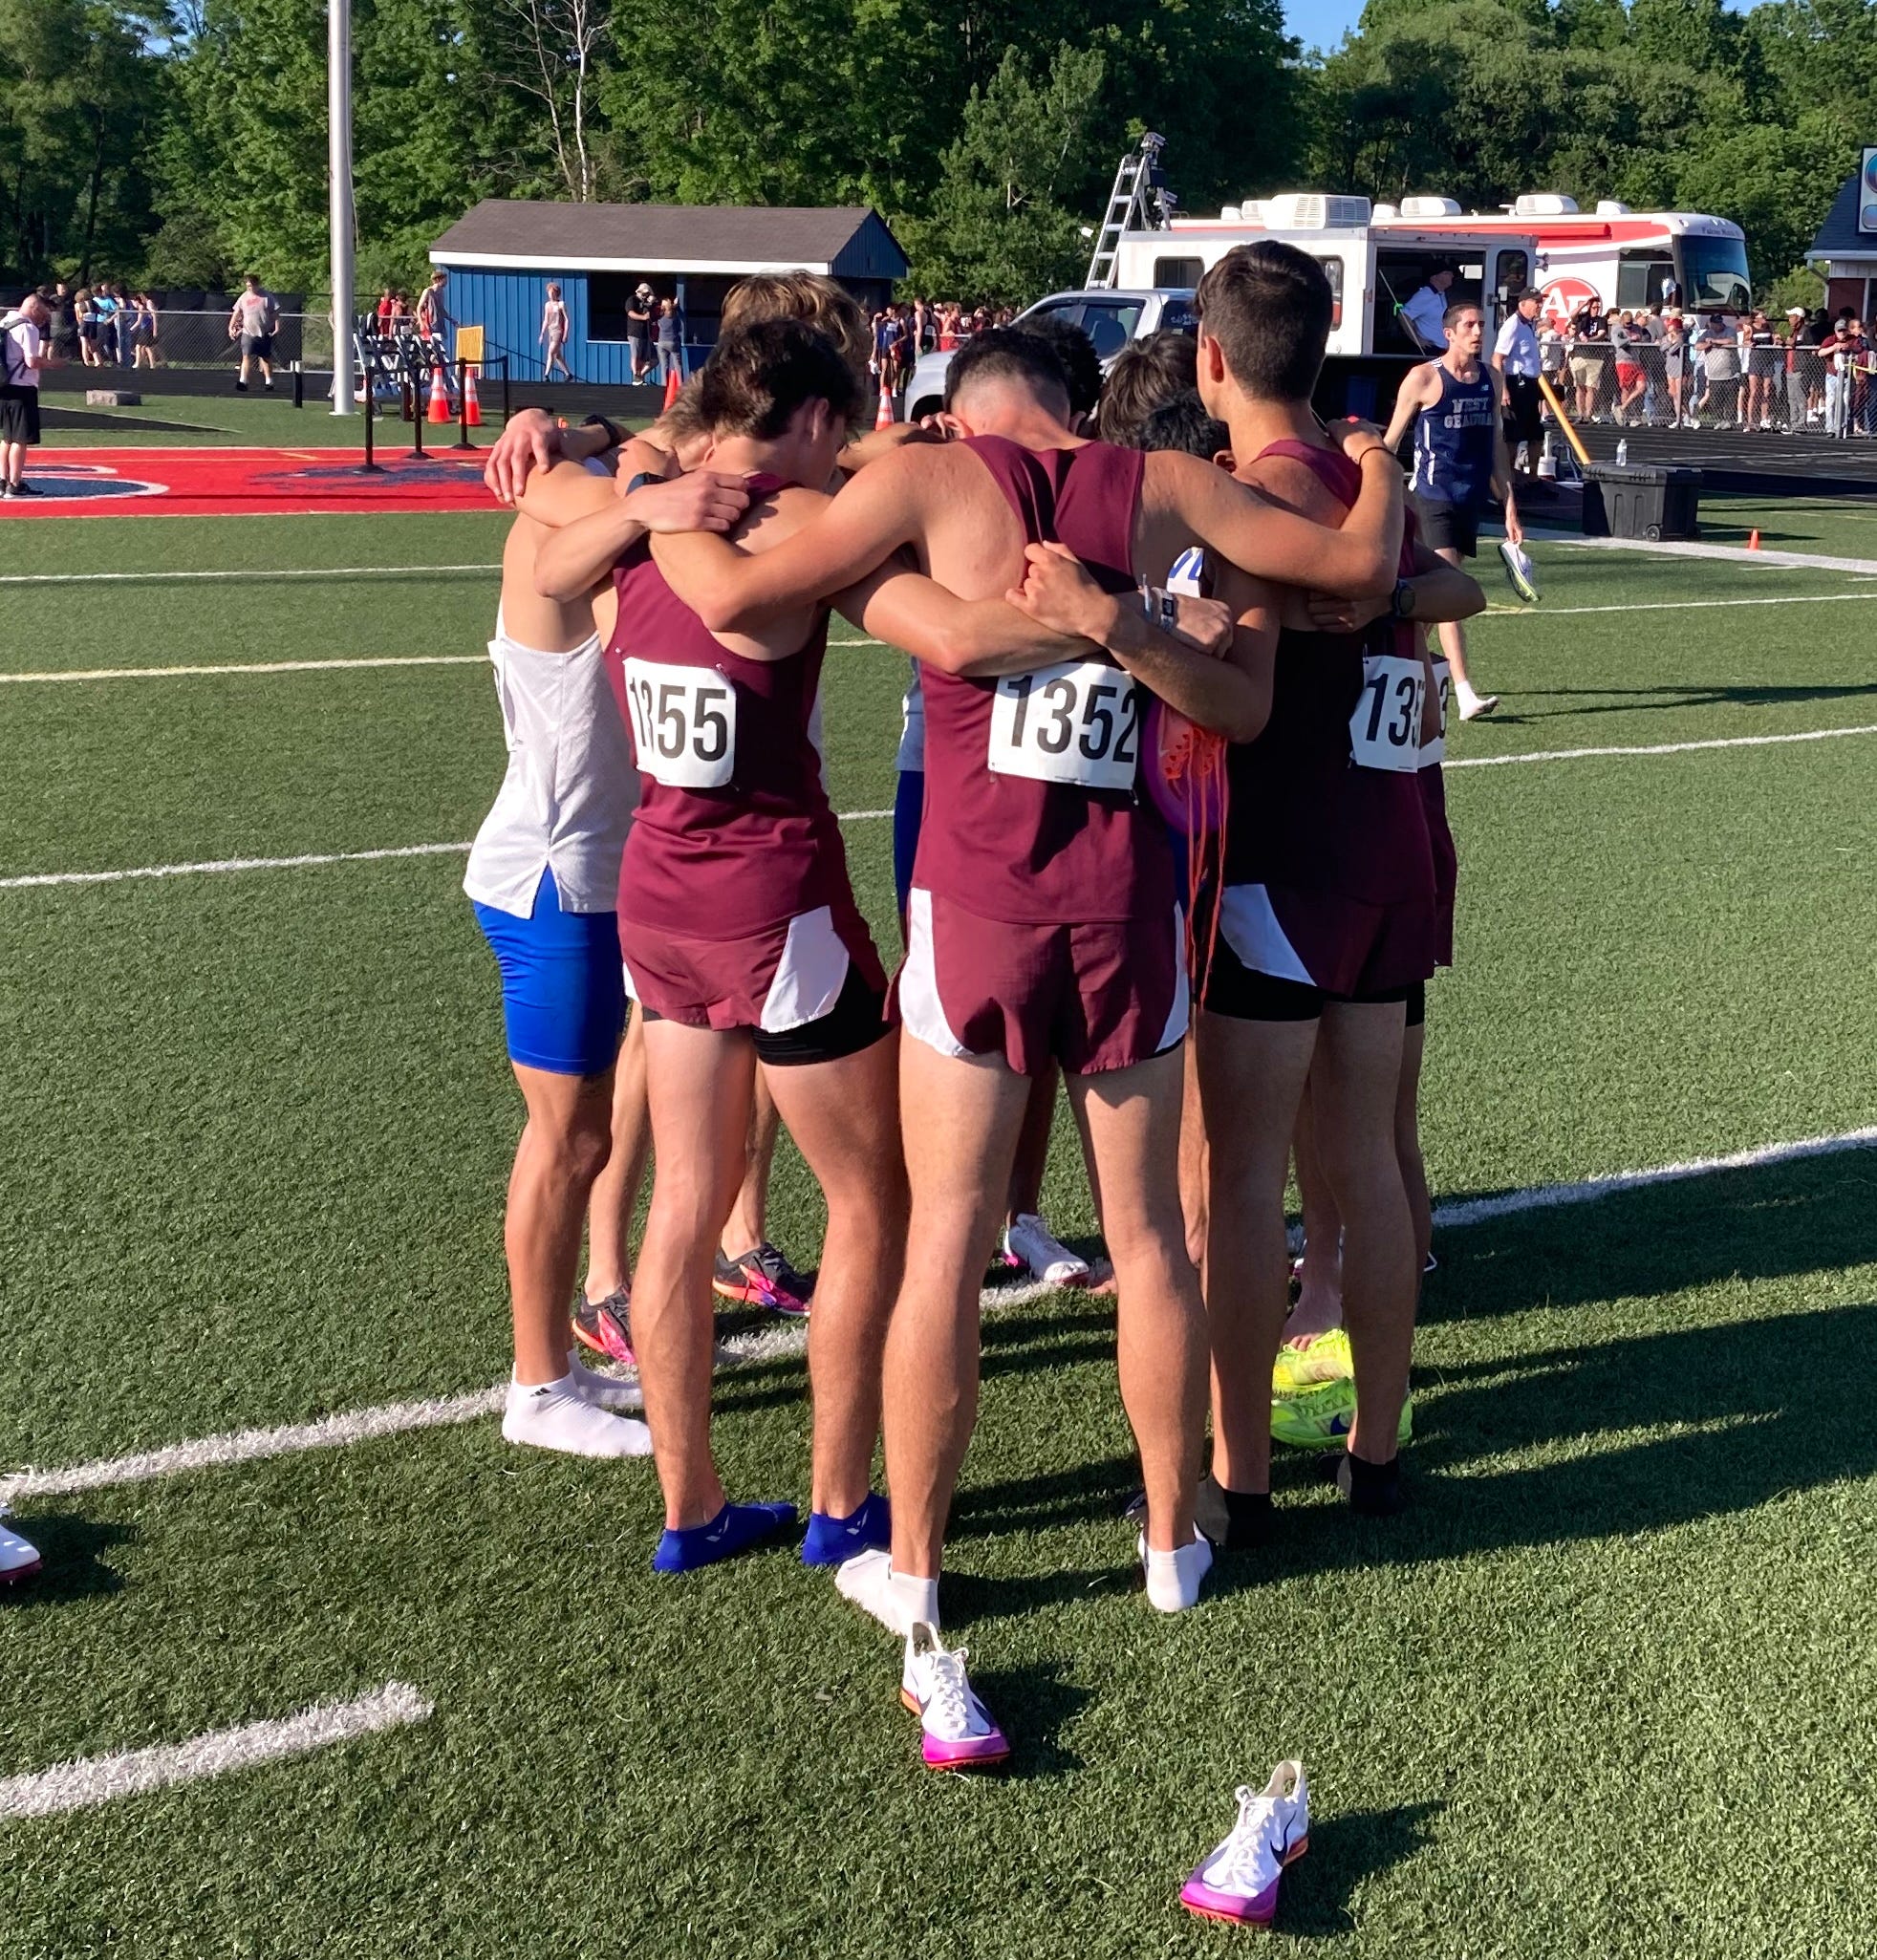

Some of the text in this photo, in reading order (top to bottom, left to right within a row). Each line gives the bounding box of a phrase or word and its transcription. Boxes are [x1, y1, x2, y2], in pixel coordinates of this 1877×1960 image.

[1452, 398, 1490, 414] WEST
[630, 677, 727, 762] 1355
[1007, 675, 1138, 764] 1352
